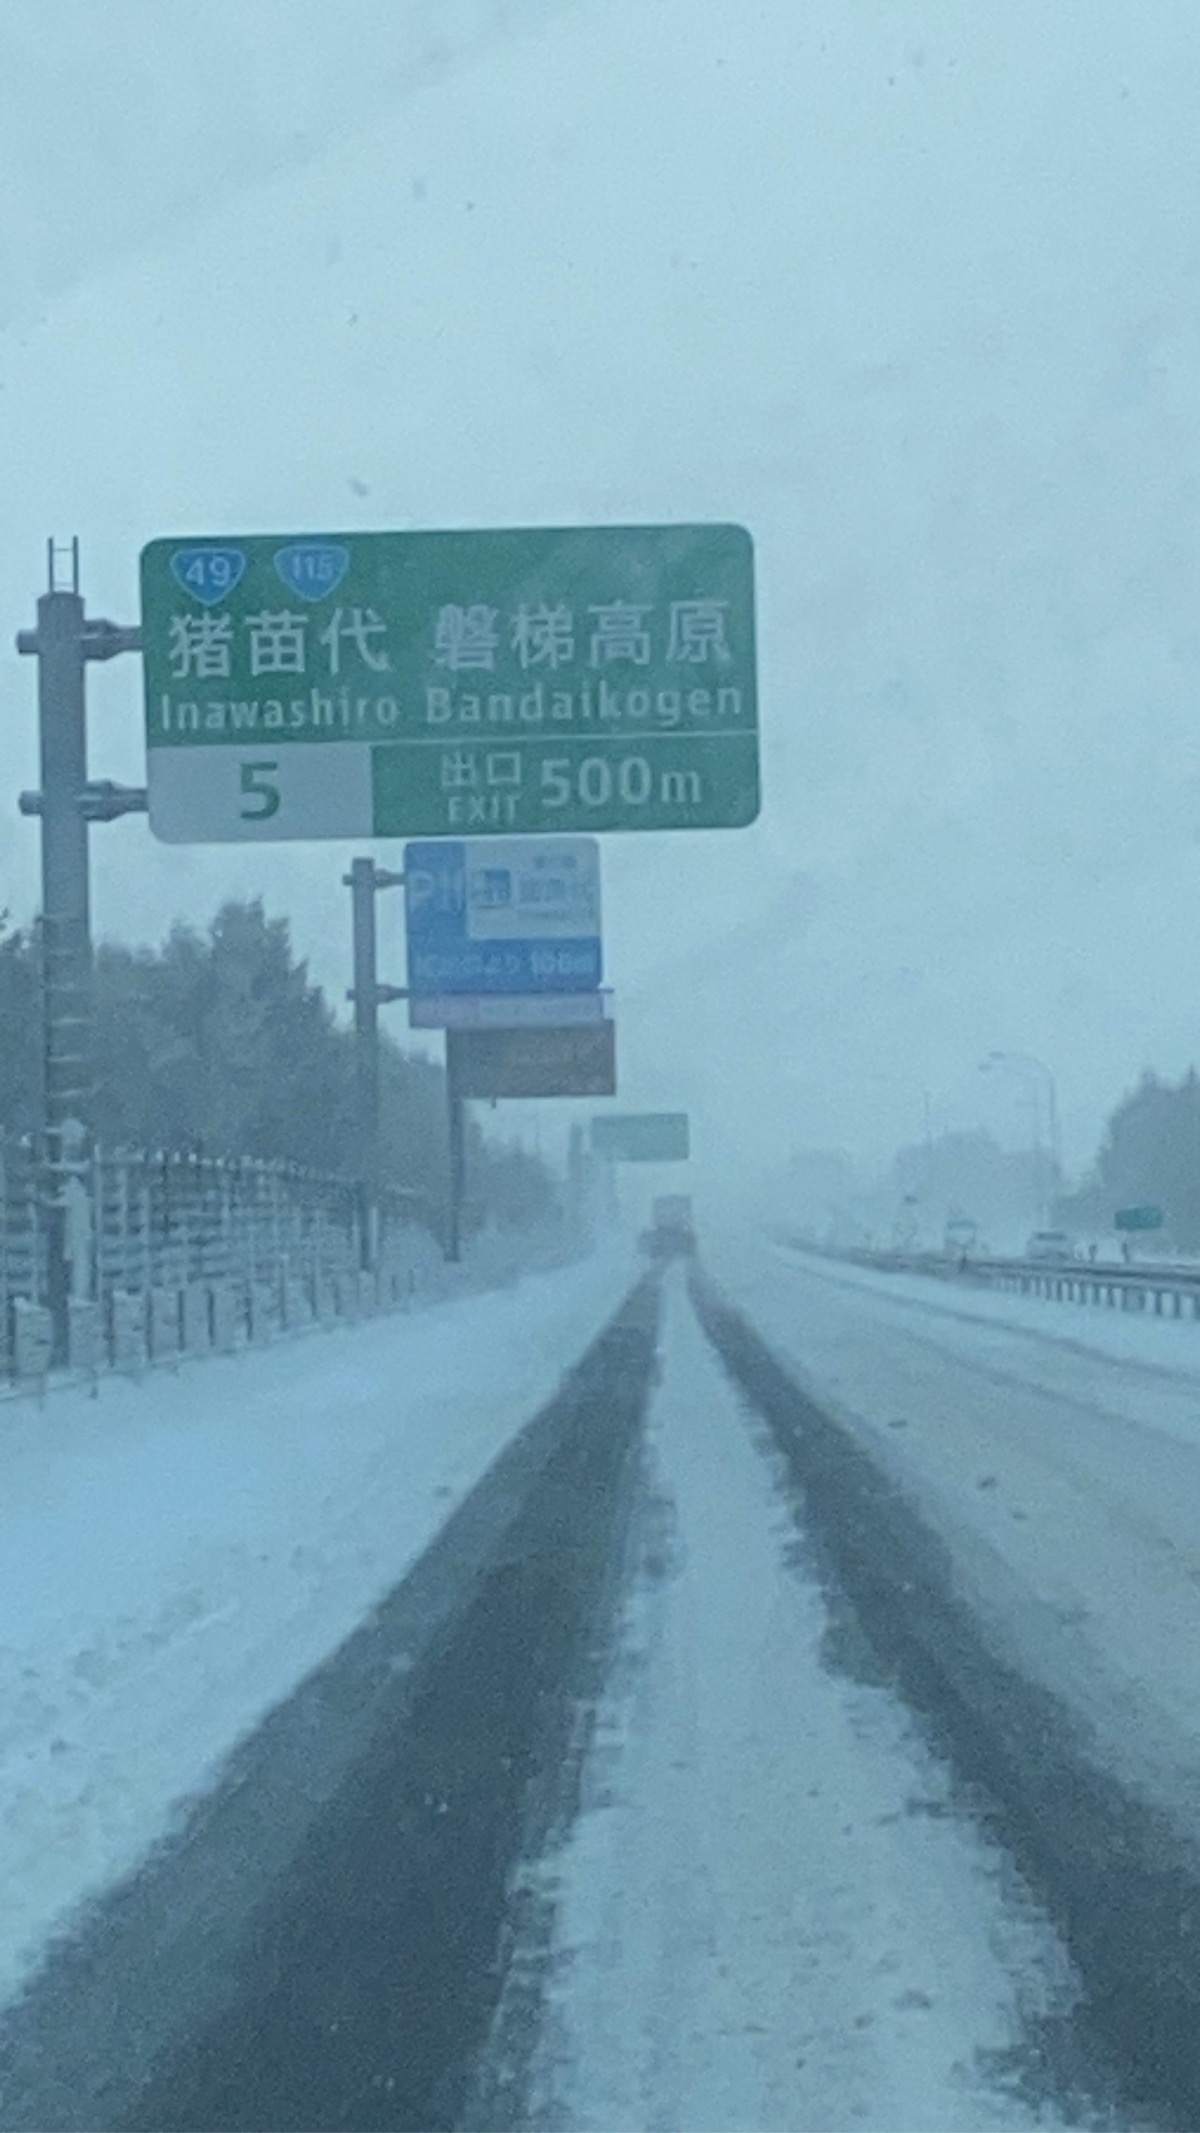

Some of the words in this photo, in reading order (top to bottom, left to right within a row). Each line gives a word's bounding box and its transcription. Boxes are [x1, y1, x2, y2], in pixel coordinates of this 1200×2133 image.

[186, 556, 230, 586] 49
[292, 553, 334, 581] 115
[169, 607, 392, 678] 猪苗代
[434, 599, 731, 671] 磐梯高原
[161, 686, 399, 731] Inawashiro
[427, 680, 742, 726] Bandaikogen
[441, 751, 521, 787] 出口
[240, 761, 281, 820] 5
[448, 794, 519, 825] EXIT
